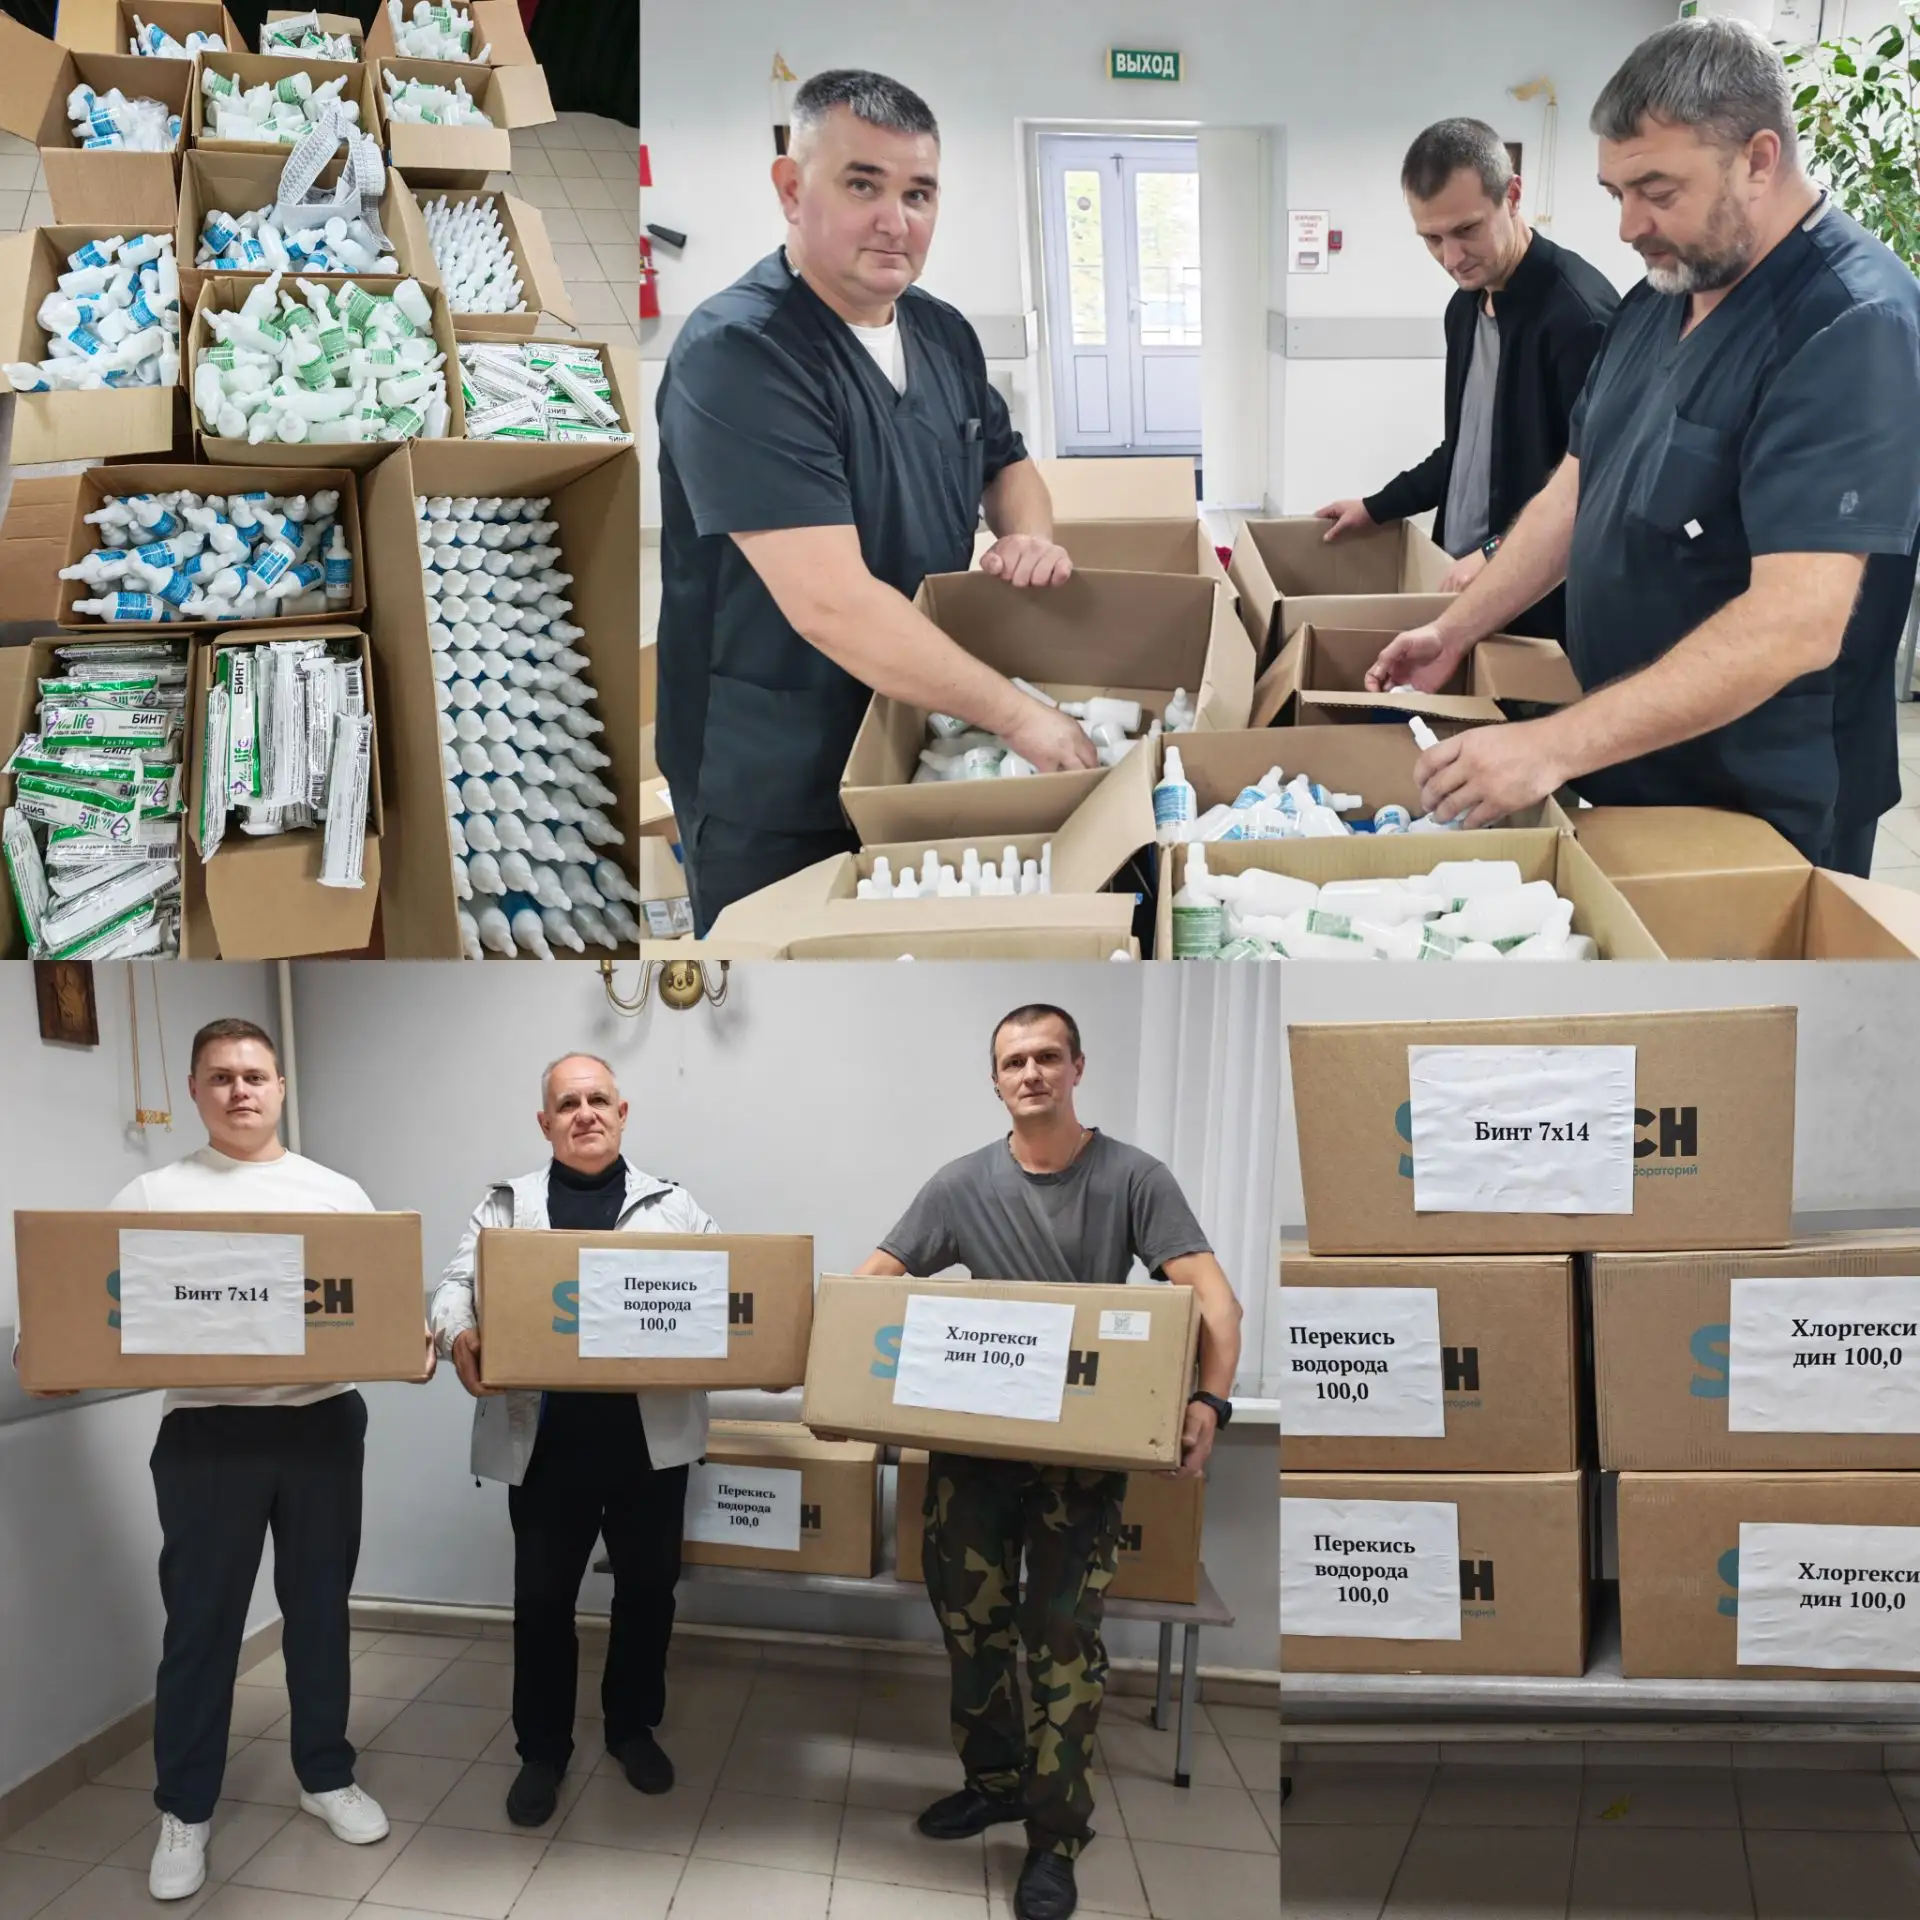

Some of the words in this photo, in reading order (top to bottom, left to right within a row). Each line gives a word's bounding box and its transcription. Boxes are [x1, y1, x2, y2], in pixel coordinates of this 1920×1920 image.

[1116, 53, 1175, 78] ВЫХОД
[232, 660, 245, 695] БИНТ
[73, 713, 95, 730] life
[131, 713, 165, 725] БИНТ
[234, 738, 249, 763] life
[16, 802, 45, 816] БИНТ
[78, 811, 98, 830] life
[1474, 1121, 1533, 1141] Бинт
[174, 1285, 223, 1301] Бинт
[623, 1277, 697, 1293] Перекись
[623, 1301, 692, 1313] водорода
[639, 1317, 677, 1333] 100,0
[1791, 1319, 1917, 1341] Хлоргекси
[946, 1326, 1038, 1347] Хлоргекси
[1290, 1326, 1396, 1348] Перекись
[944, 1349, 976, 1363] дин
[982, 1350, 1025, 1369] 100,0
[1291, 1358, 1389, 1376] водорода
[1792, 1352, 1837, 1369] дин
[1844, 1347, 1902, 1369] 100,0
[1316, 1382, 1369, 1403] 100,0
[718, 1484, 776, 1498] Перекись
[717, 1501, 771, 1514] водорода
[729, 1515, 759, 1528] 100,0
[1314, 1535, 1416, 1556] Перекись
[1314, 1564, 1409, 1581] водорода
[1798, 1562, 1920, 1585] Хлоргекси
[1337, 1586, 1389, 1606] 100,0
[1800, 1593, 1842, 1609] дин
[1849, 1592, 1906, 1612] 100,0
